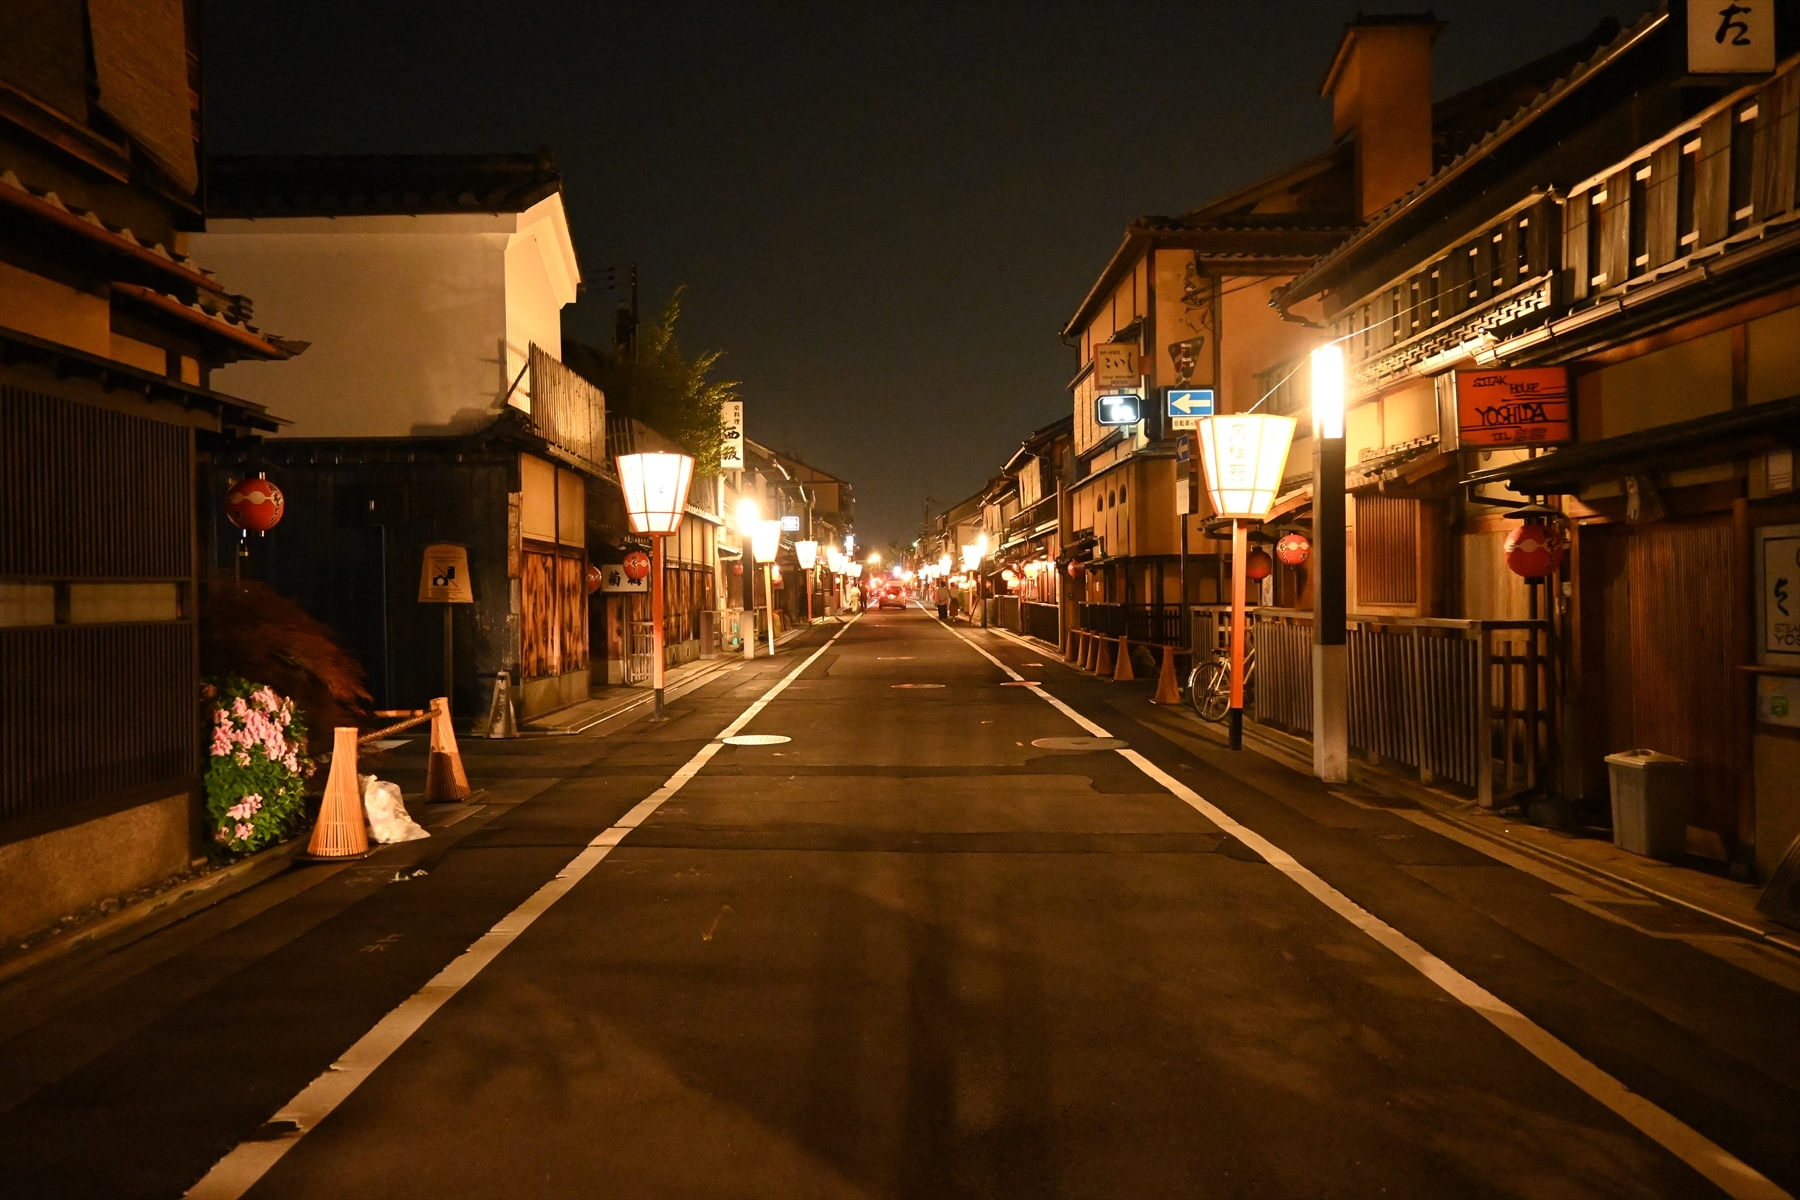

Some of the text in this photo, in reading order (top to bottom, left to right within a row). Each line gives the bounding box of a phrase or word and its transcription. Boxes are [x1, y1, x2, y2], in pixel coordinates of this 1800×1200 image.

[1474, 404, 1548, 426] YOSHIDA
[1227, 423, 1247, 482] 月桂冠
